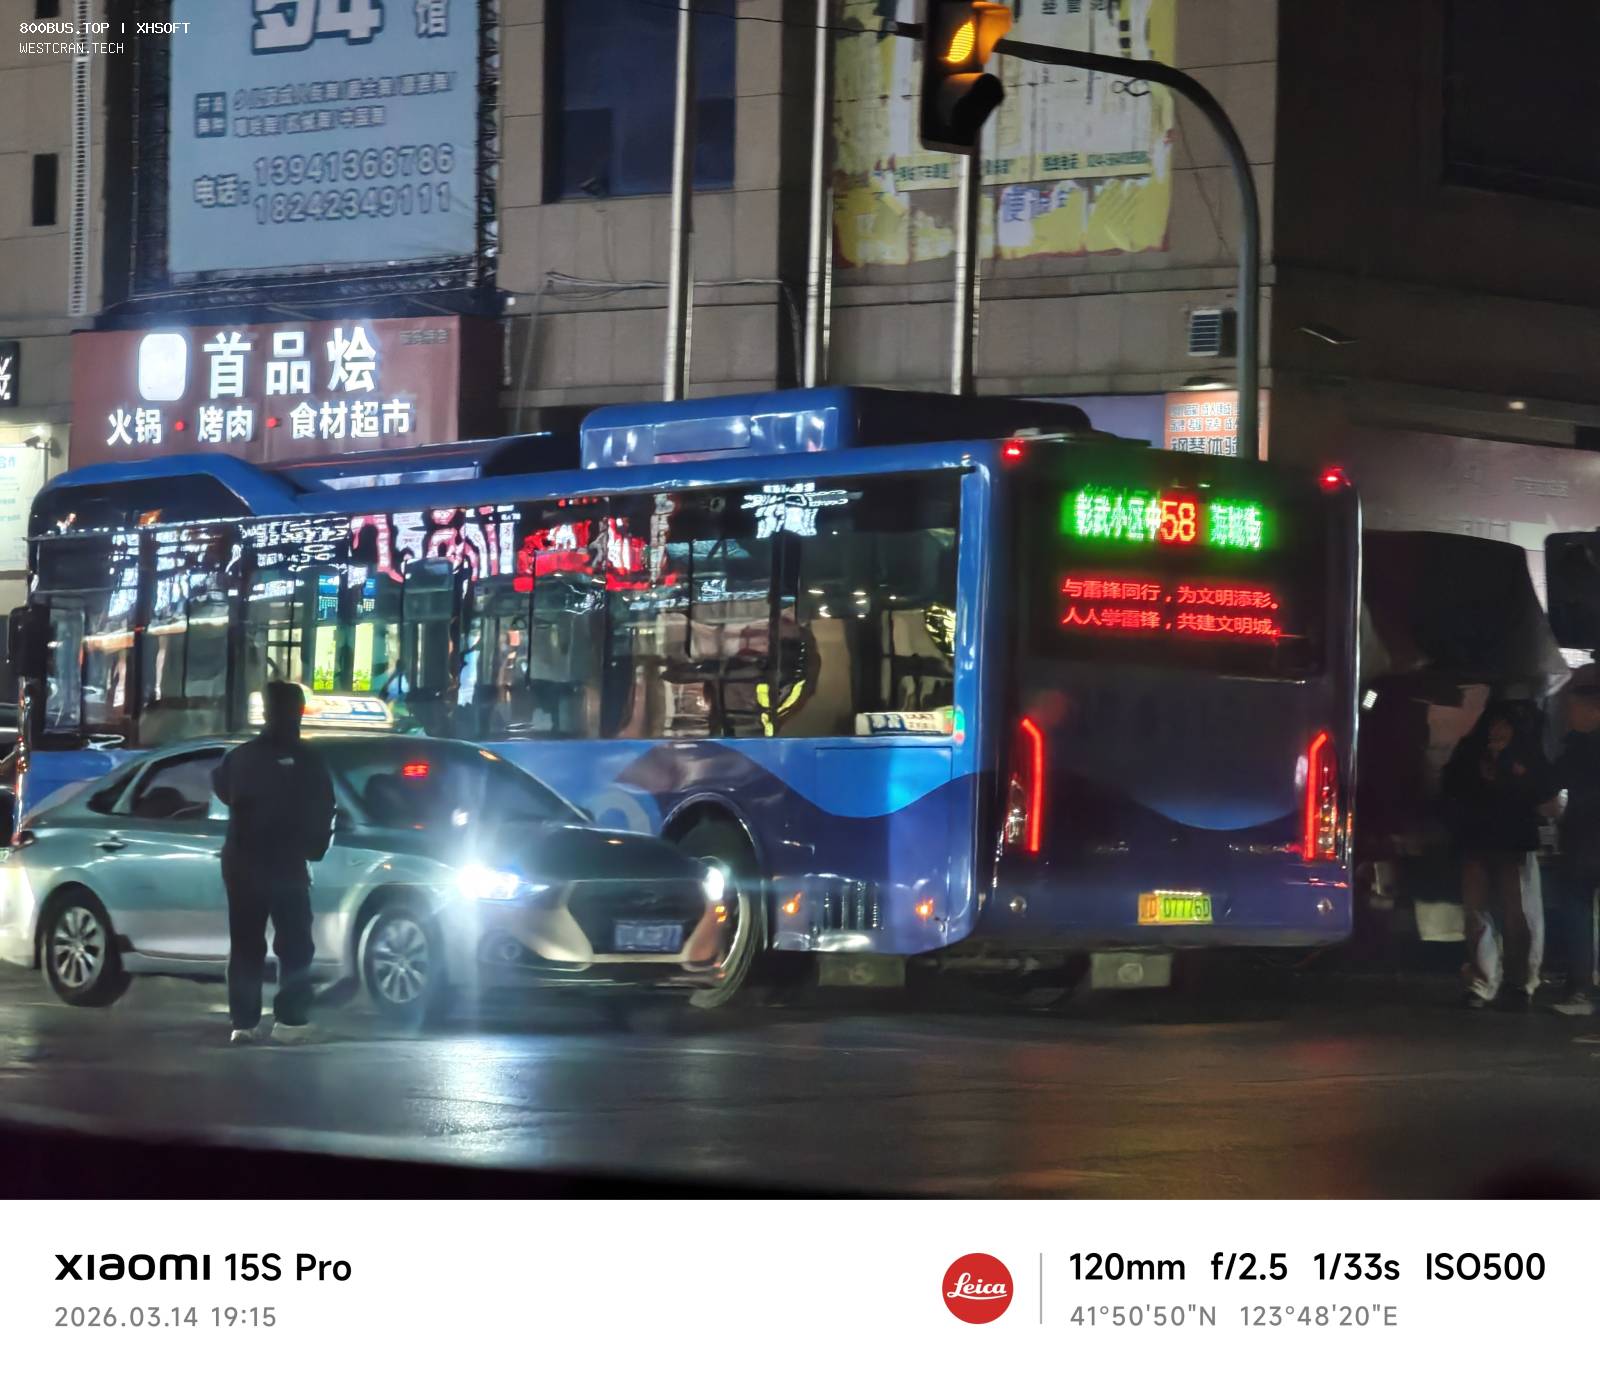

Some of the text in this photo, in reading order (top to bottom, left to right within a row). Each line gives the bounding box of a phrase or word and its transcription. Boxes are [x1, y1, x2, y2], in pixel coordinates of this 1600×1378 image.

[254, 142, 455, 187] 13941368786
[253, 181, 450, 224] 18242349111
[203, 326, 377, 399] 首品烩
[1160, 500, 1196, 542] 58
